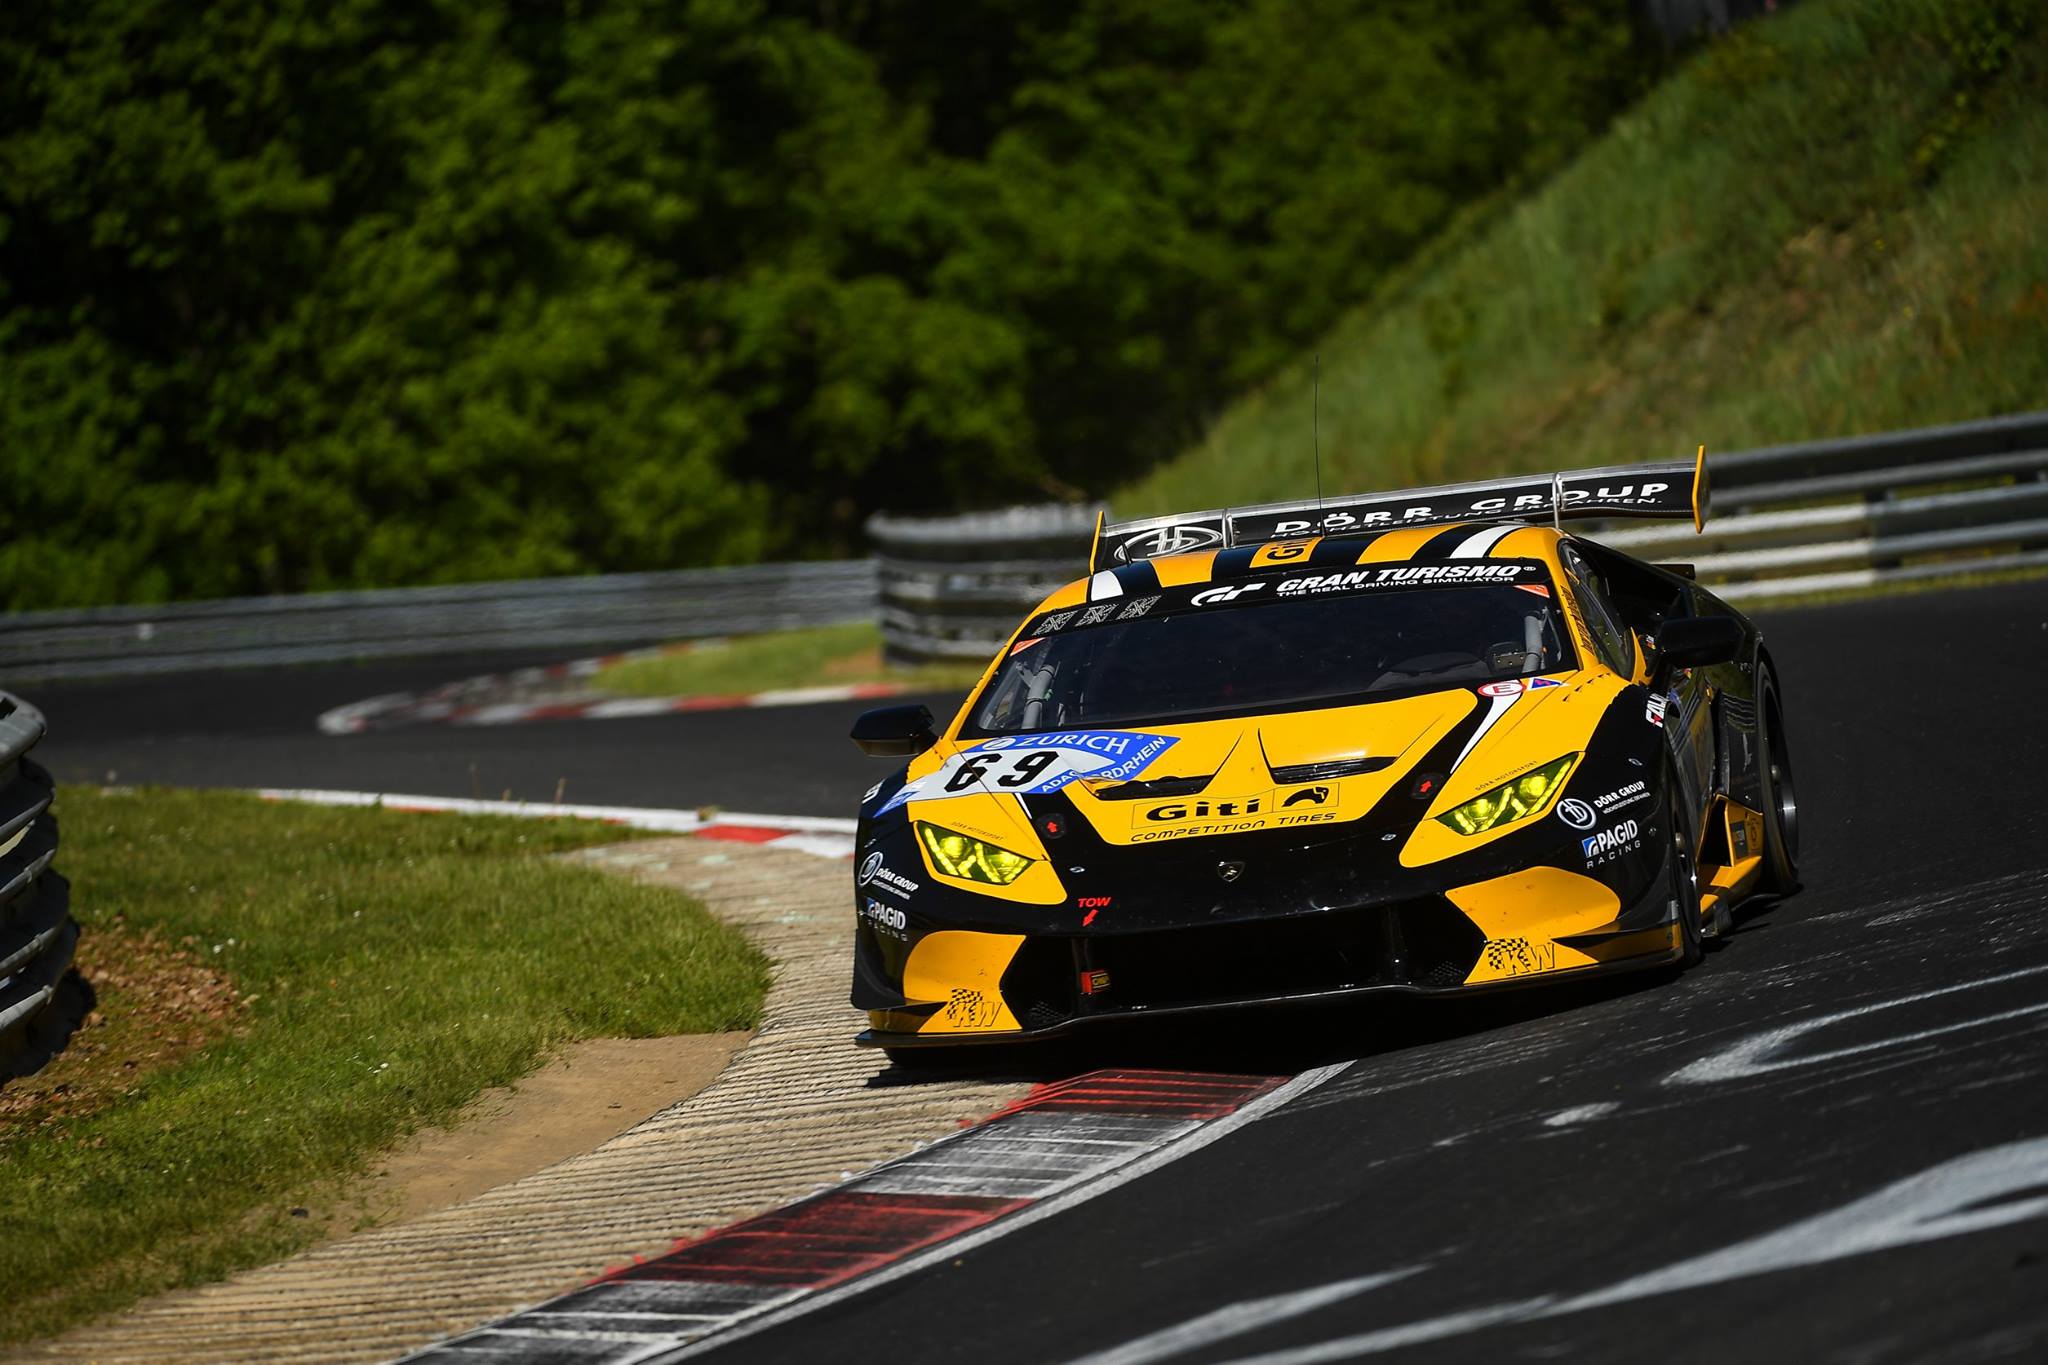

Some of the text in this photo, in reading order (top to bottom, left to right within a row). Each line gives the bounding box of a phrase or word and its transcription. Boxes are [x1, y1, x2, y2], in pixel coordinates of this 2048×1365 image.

[1275, 483, 1669, 534] DÖRR GROUP
[1276, 565, 1522, 593] GRAN TURISMO
[1311, 584, 1350, 594] REAL
[1354, 578, 1419, 590] DRIVING
[1422, 576, 1515, 585] SIMULATOR
[1014, 734, 1131, 755] ZURICH
[944, 751, 1059, 793] 69
[1593, 792, 1620, 808] DÖRR
[1618, 780, 1646, 797] GROUP
[1146, 798, 1260, 821] Giti
[1131, 812, 1337, 842] COMPETITION TIRES
[1598, 819, 1639, 852] PAGID
[1586, 839, 1641, 870] RACING
[873, 901, 907, 930] PAGID
[1078, 897, 1111, 907] TOW
[1502, 943, 1556, 976] KW
[952, 1001, 1003, 1028] KW
